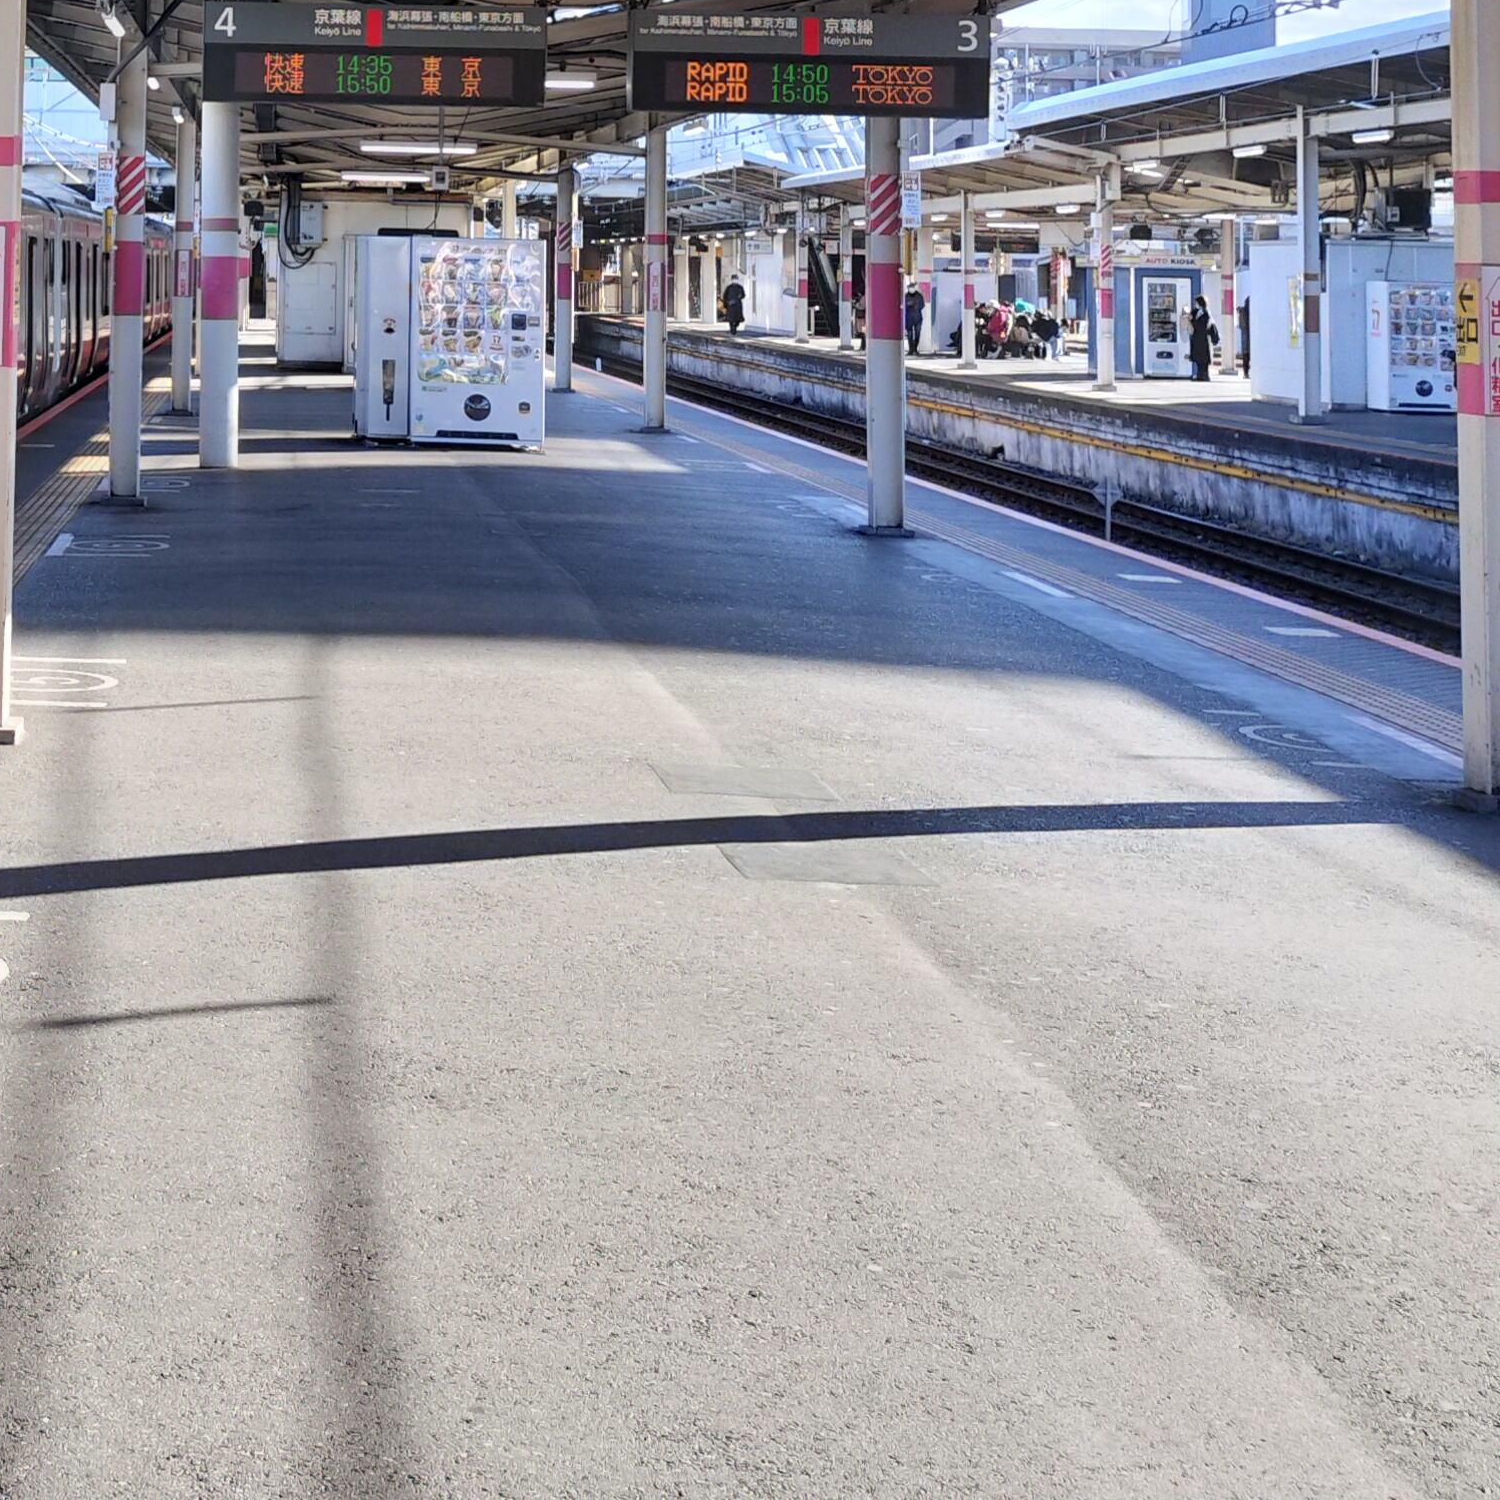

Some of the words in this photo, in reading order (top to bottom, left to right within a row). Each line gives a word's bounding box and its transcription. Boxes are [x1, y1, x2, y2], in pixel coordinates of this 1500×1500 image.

[214, 6, 237, 38] 4
[314, 8, 362, 25] 京葉線
[823, 18, 874, 35] 京葉線
[342, 27, 362, 37] Line
[852, 36, 873, 46] Line
[957, 19, 978, 51] 3
[264, 52, 305, 73] 快速
[336, 55, 393, 74] 14:35
[686, 61, 748, 82] RAPID
[771, 63, 829, 83] 14:50
[264, 73, 304, 94] 快速
[336, 75, 391, 94] 15:50
[686, 82, 748, 103] RAPID
[771, 84, 829, 104] 15:05
[1170, 258, 1196, 266] KIOSK
[1457, 316, 1479, 344] 出口
